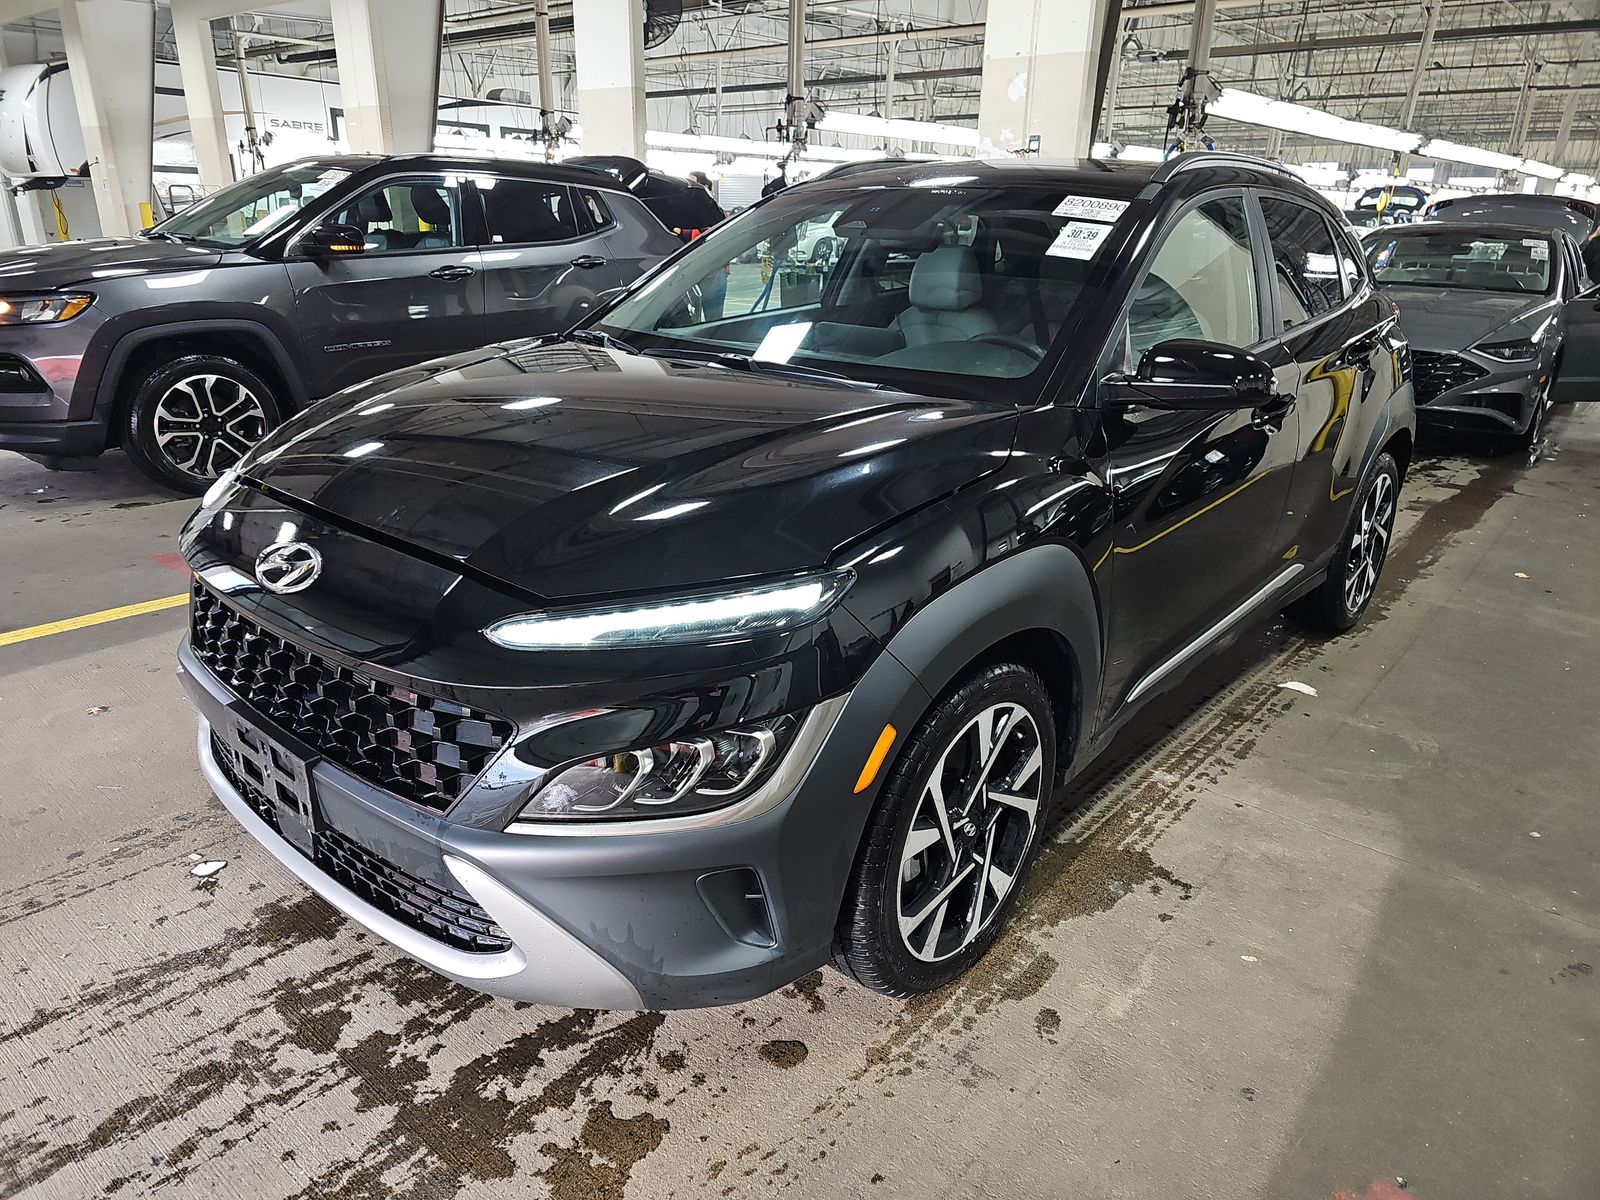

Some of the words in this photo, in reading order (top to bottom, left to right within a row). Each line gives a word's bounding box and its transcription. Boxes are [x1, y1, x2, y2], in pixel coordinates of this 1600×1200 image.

[270, 118, 324, 131] SABRE
[1064, 197, 1127, 212] 8200890
[1067, 229, 1099, 241] 30:39
